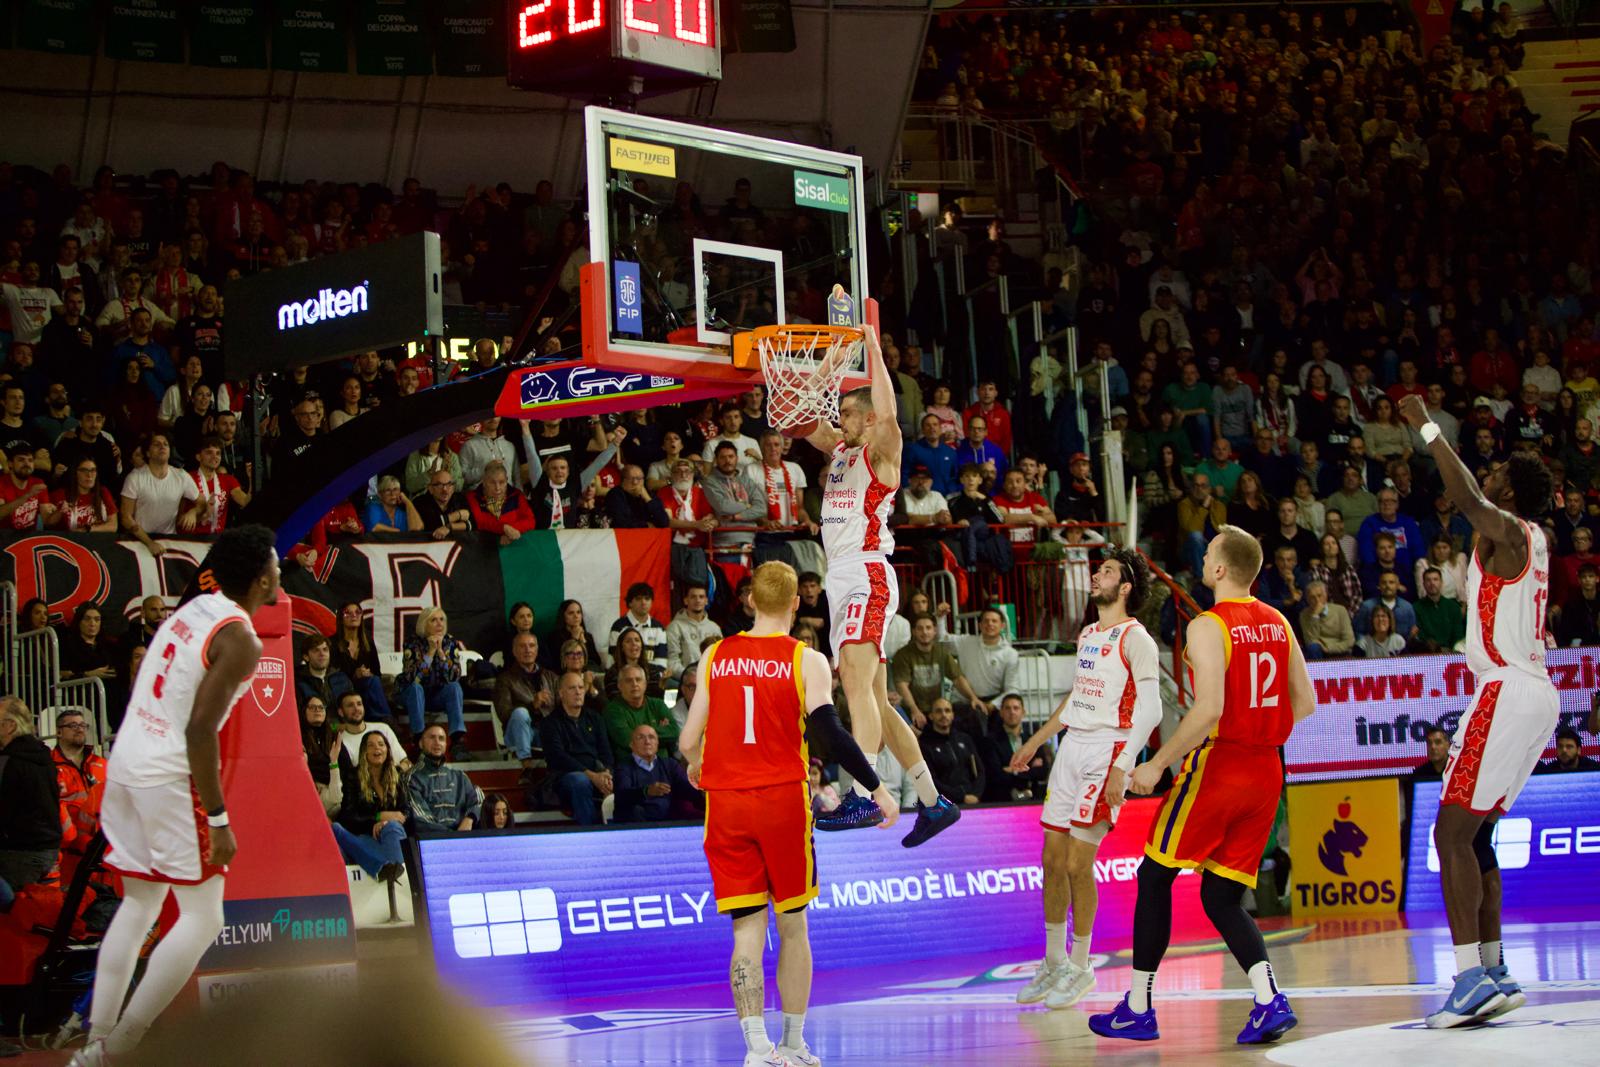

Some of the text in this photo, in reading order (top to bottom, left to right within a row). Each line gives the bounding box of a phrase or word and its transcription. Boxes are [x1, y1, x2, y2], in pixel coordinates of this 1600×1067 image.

[200, 5, 254, 16] CAMPIONATO
[295, 10, 321, 19] COPPA
[377, 14, 405, 23] COPPA
[209, 15, 247, 25] ITALIANO
[443, 17, 494, 27] CAMPIONATO
[451, 26, 486, 35] ITALIANO
[615, 147, 671, 166] FASTWEB
[794, 177, 849, 206] Sisal Club
[277, 283, 368, 331] molten
[618, 308, 640, 320] FIP
[831, 312, 852, 326] LBA
[846, 602, 862, 619] 11
[255, 661, 283, 674] ARESE
[711, 657, 792, 680] MANNION
[1248, 651, 1279, 709] 12
[742, 685, 757, 745] 1
[1083, 783, 1097, 801] 2
[831, 876, 922, 908] MONDO
[928, 869, 943, 900] È
[943, 872, 966, 898] IL
[966, 866, 1044, 896] NOSTR
[1296, 879, 1396, 908] TIGROS
[567, 891, 710, 935] GEELY
[291, 917, 348, 941] ARENA
